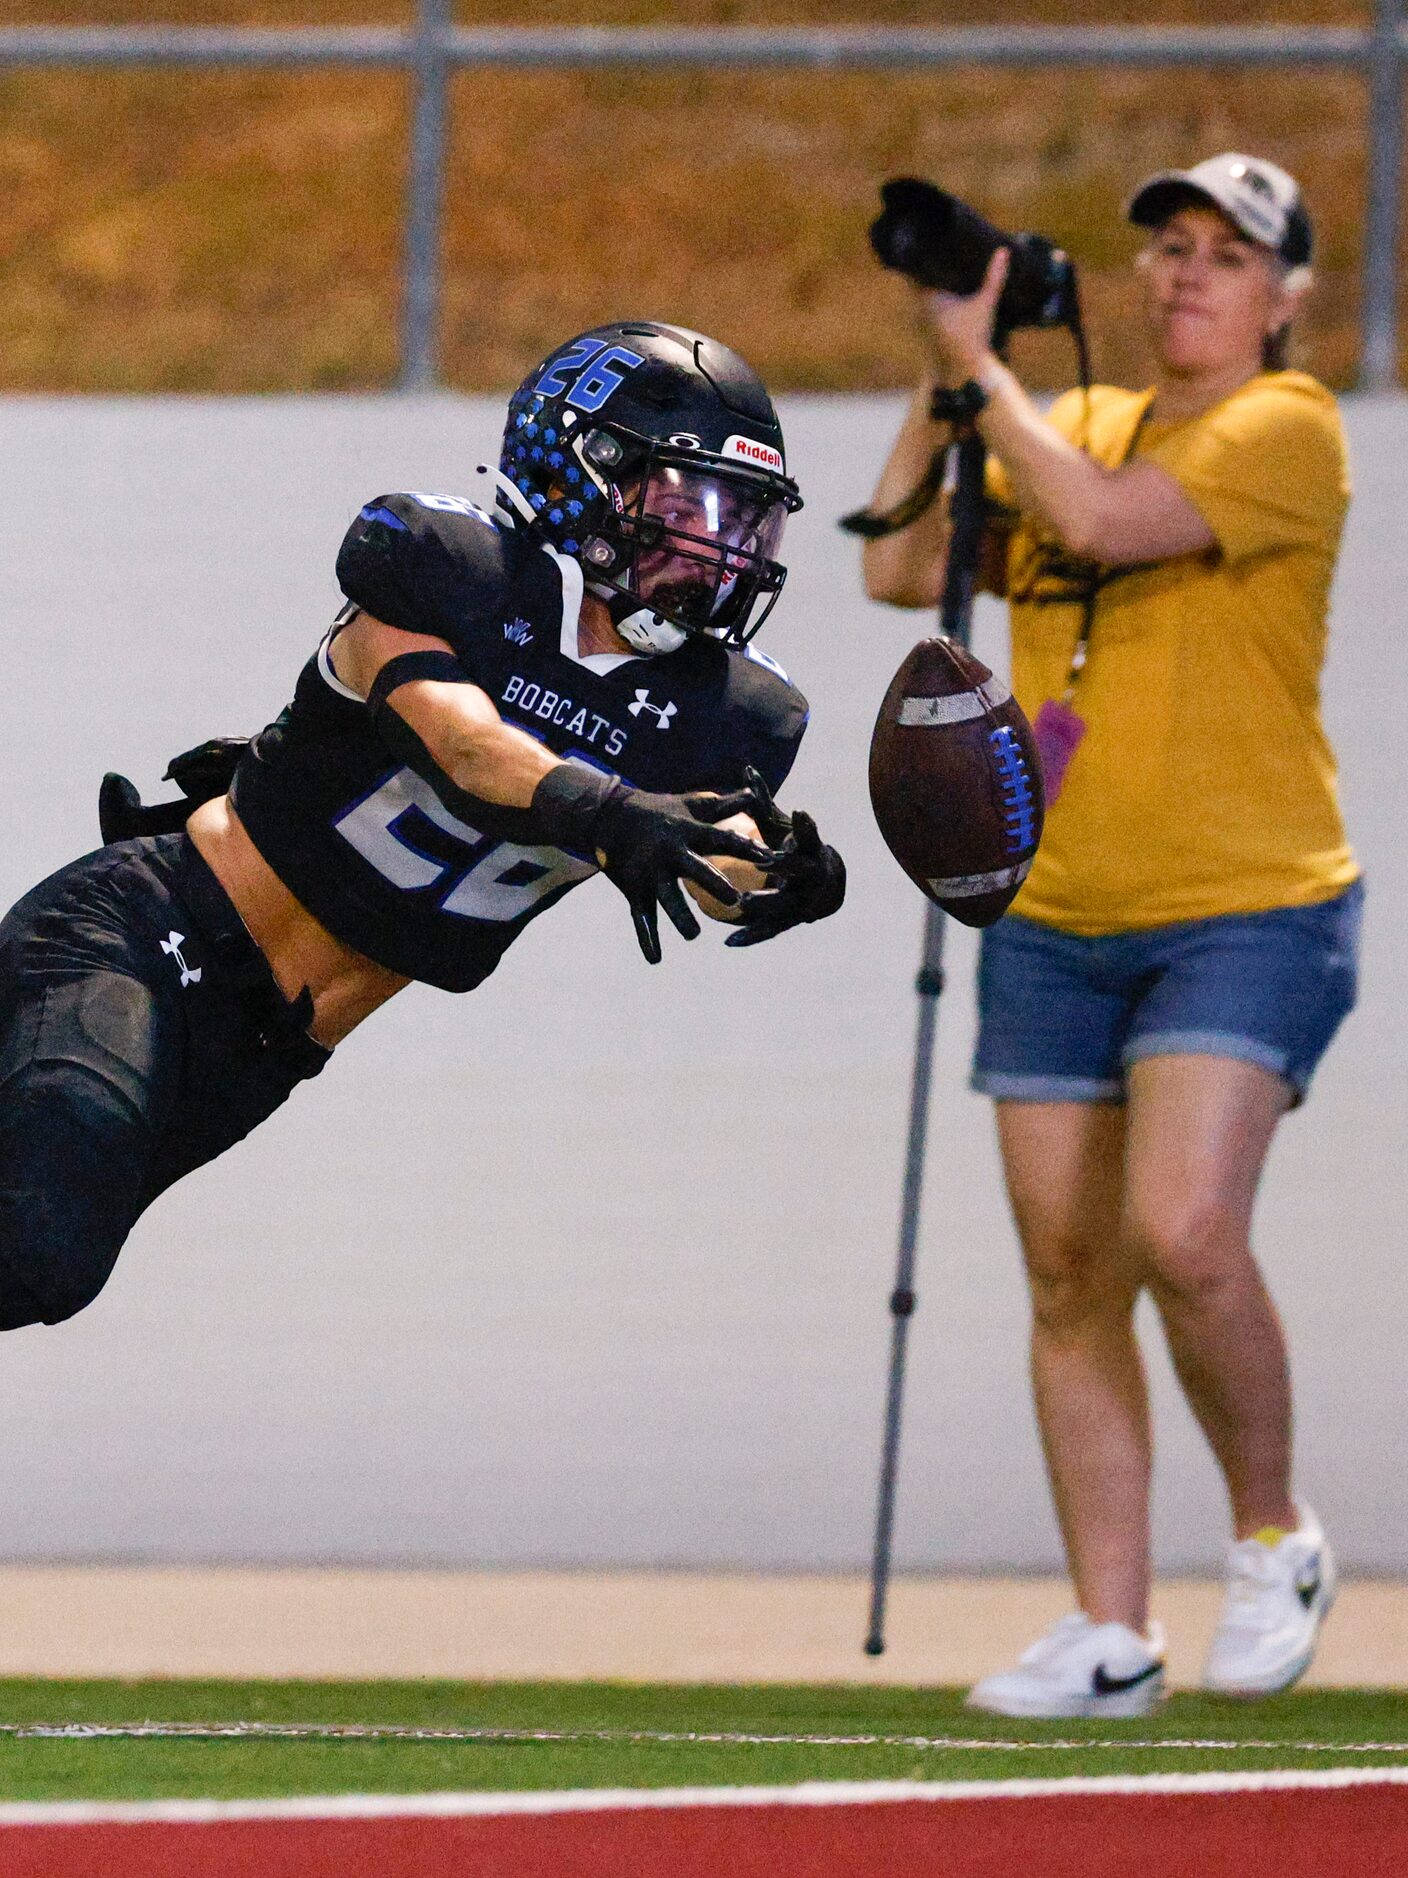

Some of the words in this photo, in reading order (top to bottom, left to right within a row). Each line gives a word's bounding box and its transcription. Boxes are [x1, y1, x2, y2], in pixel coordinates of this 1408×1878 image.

[533, 338, 646, 413] 26
[736, 440, 780, 467] Riddell
[501, 675, 628, 756] BOBCATS
